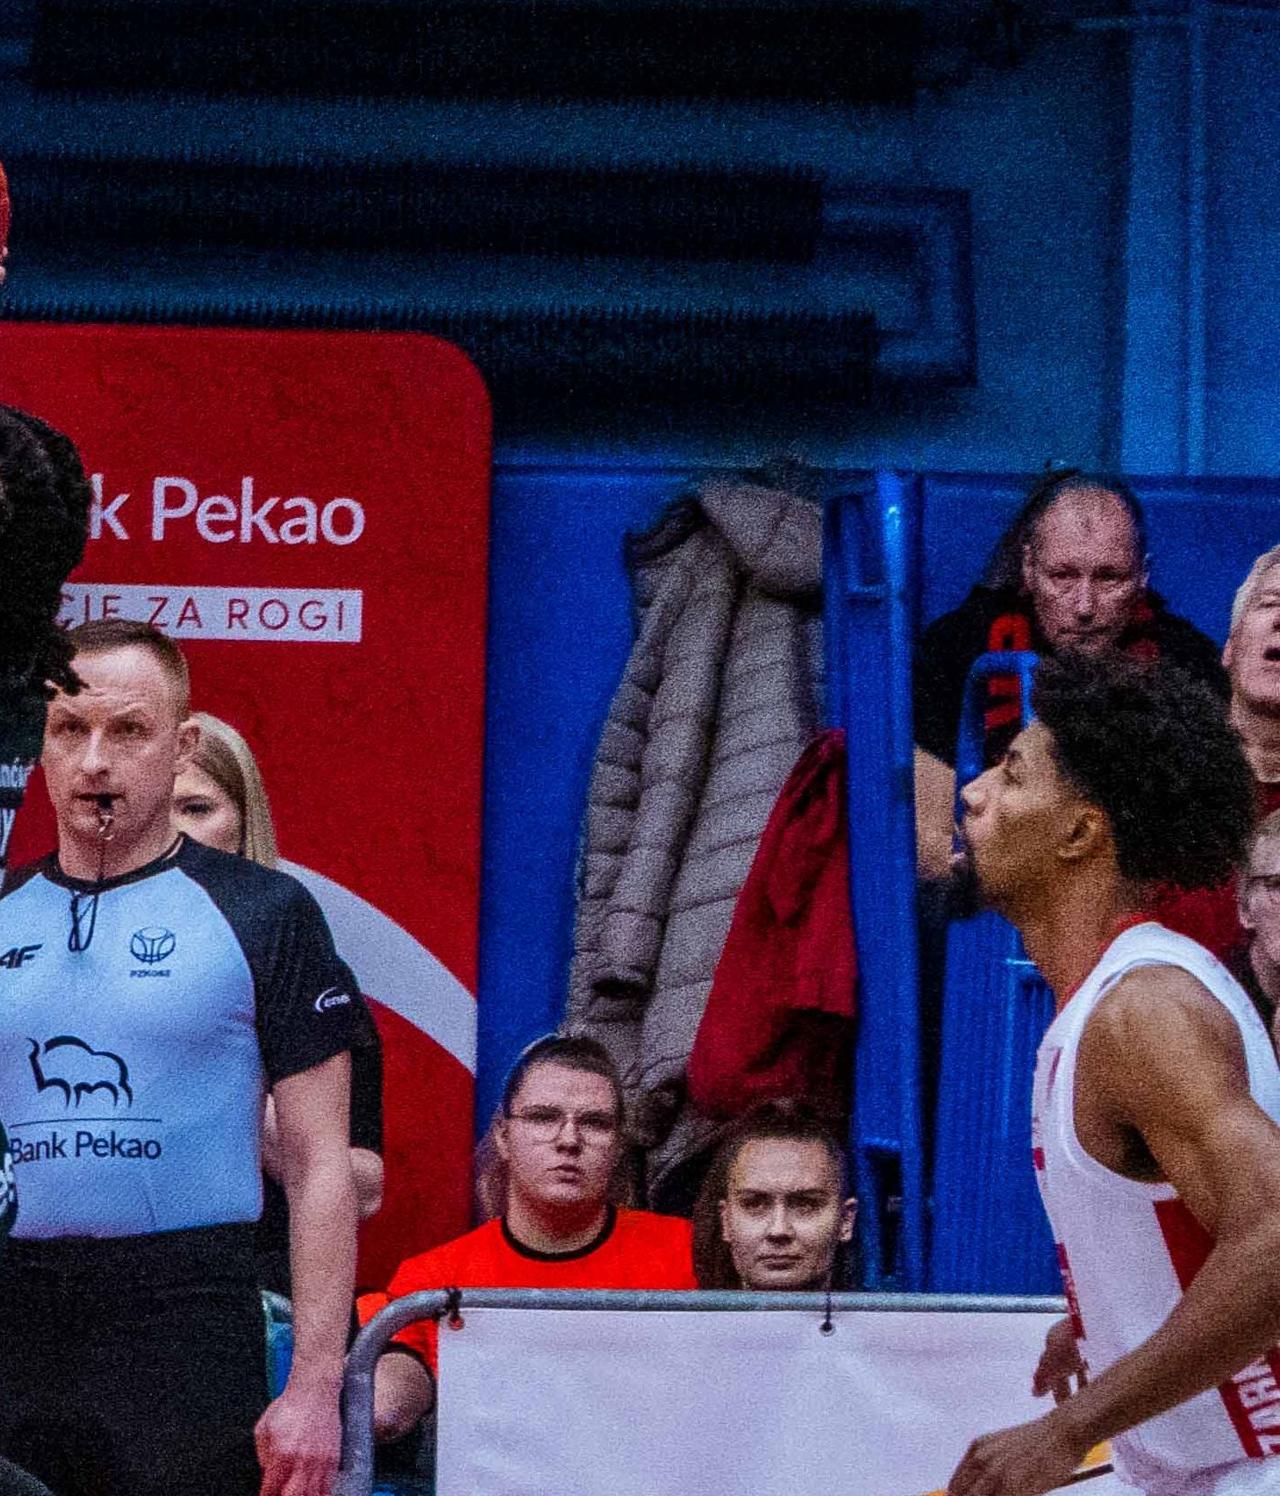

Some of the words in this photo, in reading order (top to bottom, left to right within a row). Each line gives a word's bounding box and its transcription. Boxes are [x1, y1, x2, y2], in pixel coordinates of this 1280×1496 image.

[152, 474, 366, 546] Pekao
[147, 596, 203, 629] ZA
[227, 597, 345, 631] ROGI
[9, 1128, 67, 1165] Bank
[74, 1129, 162, 1161] Pekao
